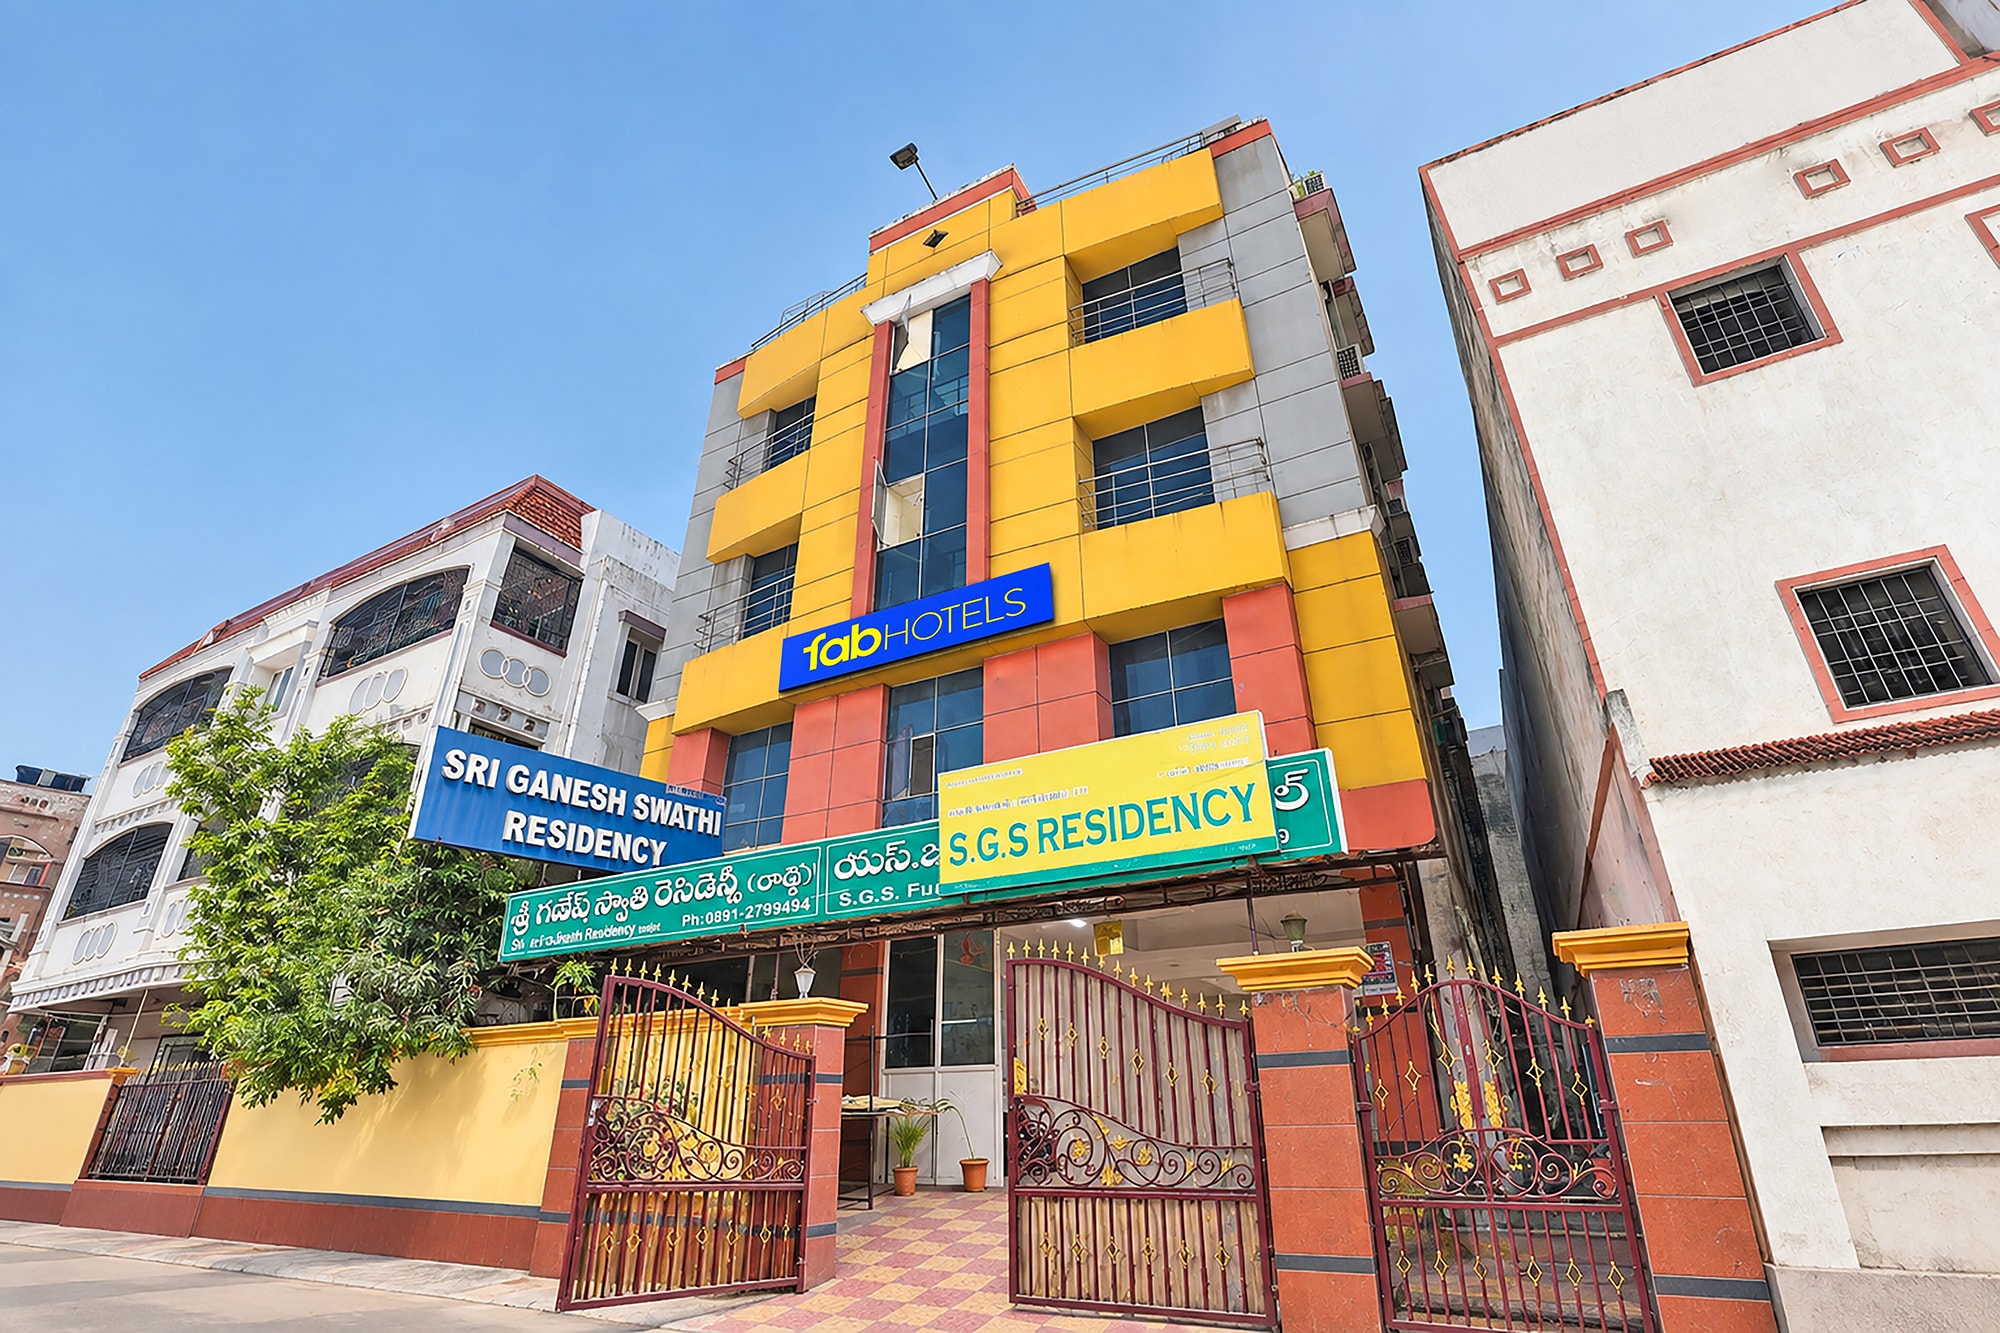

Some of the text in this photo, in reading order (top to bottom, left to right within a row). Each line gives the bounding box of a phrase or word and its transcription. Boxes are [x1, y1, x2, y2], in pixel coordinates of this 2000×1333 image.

[803, 587, 1026, 671] fabHOTELS
[441, 749, 722, 837] SRI GANESH SWATHI
[949, 822, 1031, 868] S.G.S
[1036, 782, 1255, 855] RESIDENCY
[502, 810, 667, 868] RESIDENCY
[682, 897, 811, 927] Ph:0891-2799494
[838, 886, 899, 907] S.G.S.
